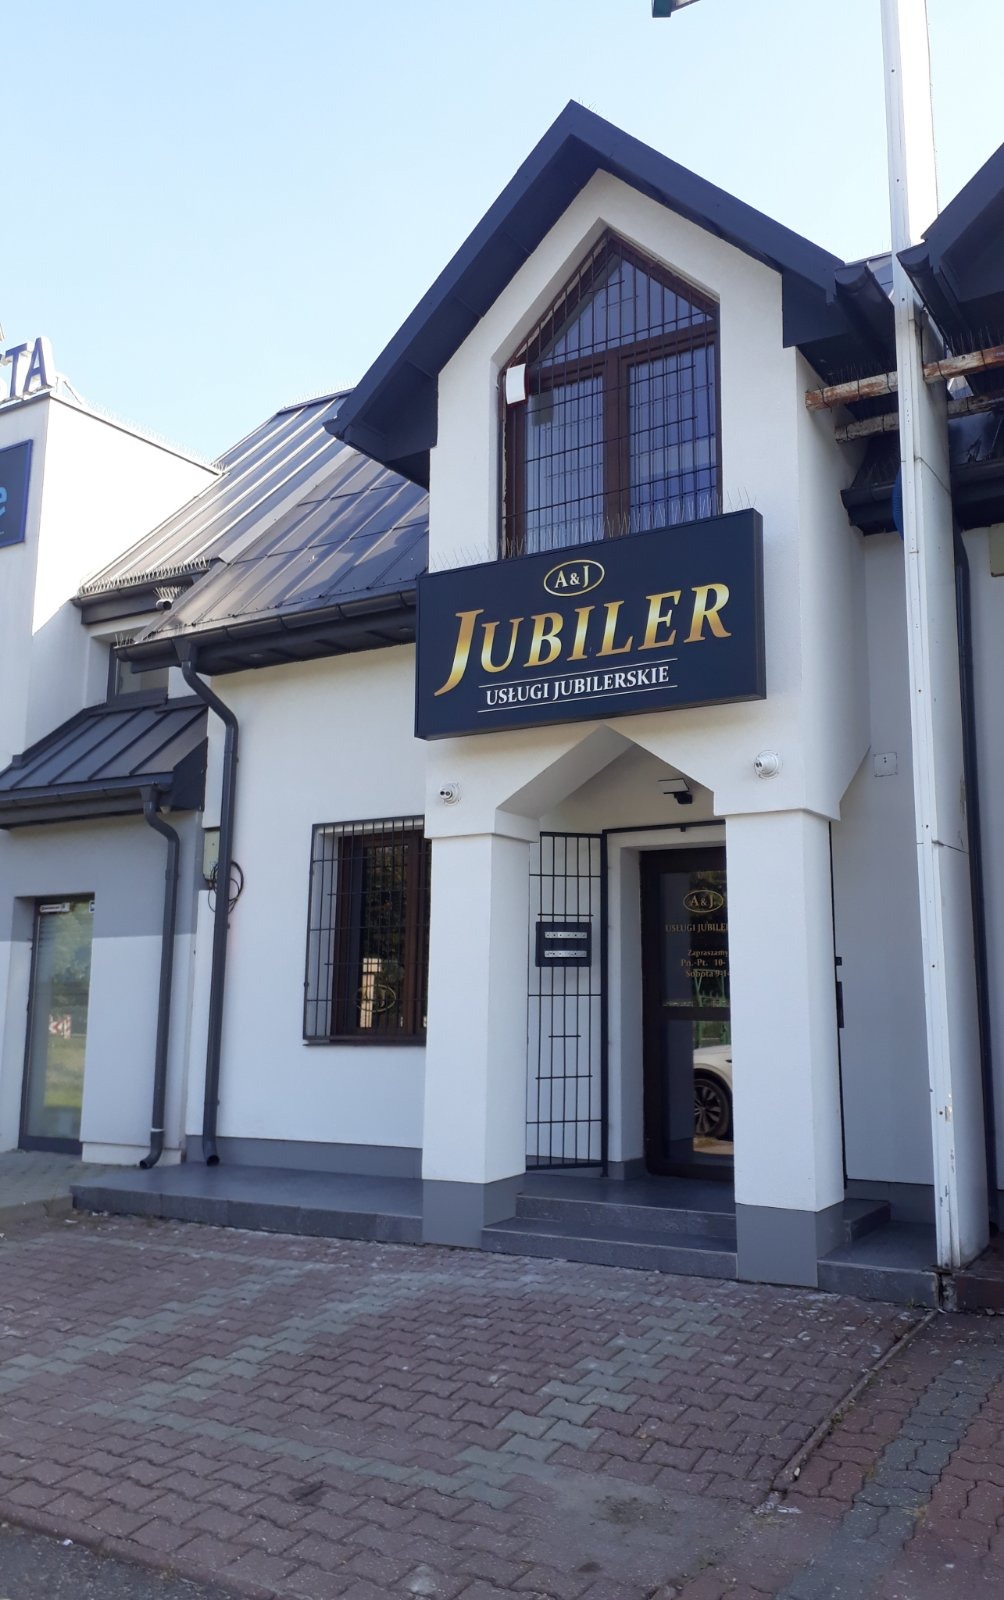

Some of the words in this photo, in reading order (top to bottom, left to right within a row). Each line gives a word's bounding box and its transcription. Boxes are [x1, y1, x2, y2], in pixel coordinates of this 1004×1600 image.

[0, 336, 49, 399] TA
[554, 564, 590, 589] A&J
[434, 583, 732, 697] JUBILER
[486, 682, 550, 706] USŁUGI
[552, 665, 670, 701] JUBILERSKIE
